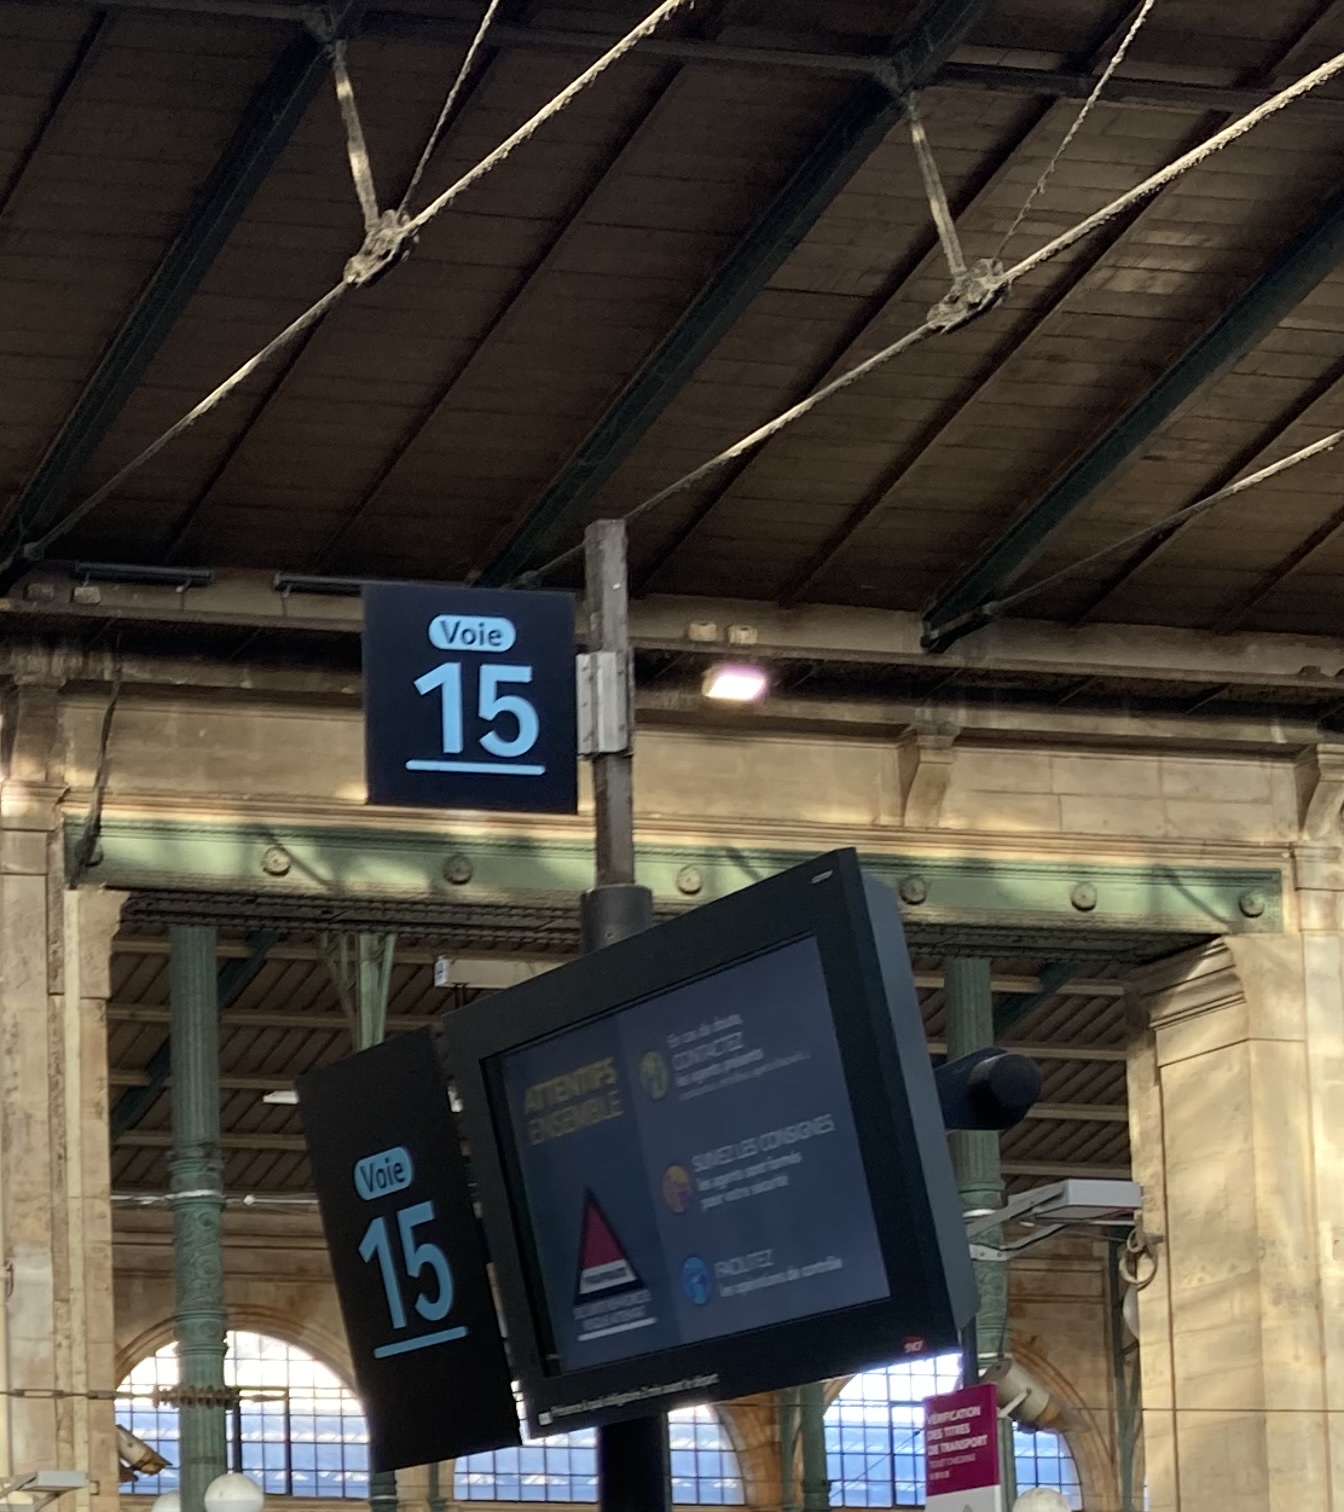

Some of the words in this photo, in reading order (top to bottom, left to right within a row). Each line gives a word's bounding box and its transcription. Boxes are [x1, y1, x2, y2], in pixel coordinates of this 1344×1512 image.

[440, 620, 503, 647] Voie
[414, 662, 539, 757] 15
[359, 1154, 407, 1192] Voie
[358, 1201, 454, 1329] 15
[940, 1434, 988, 1452] TRANSPORT
